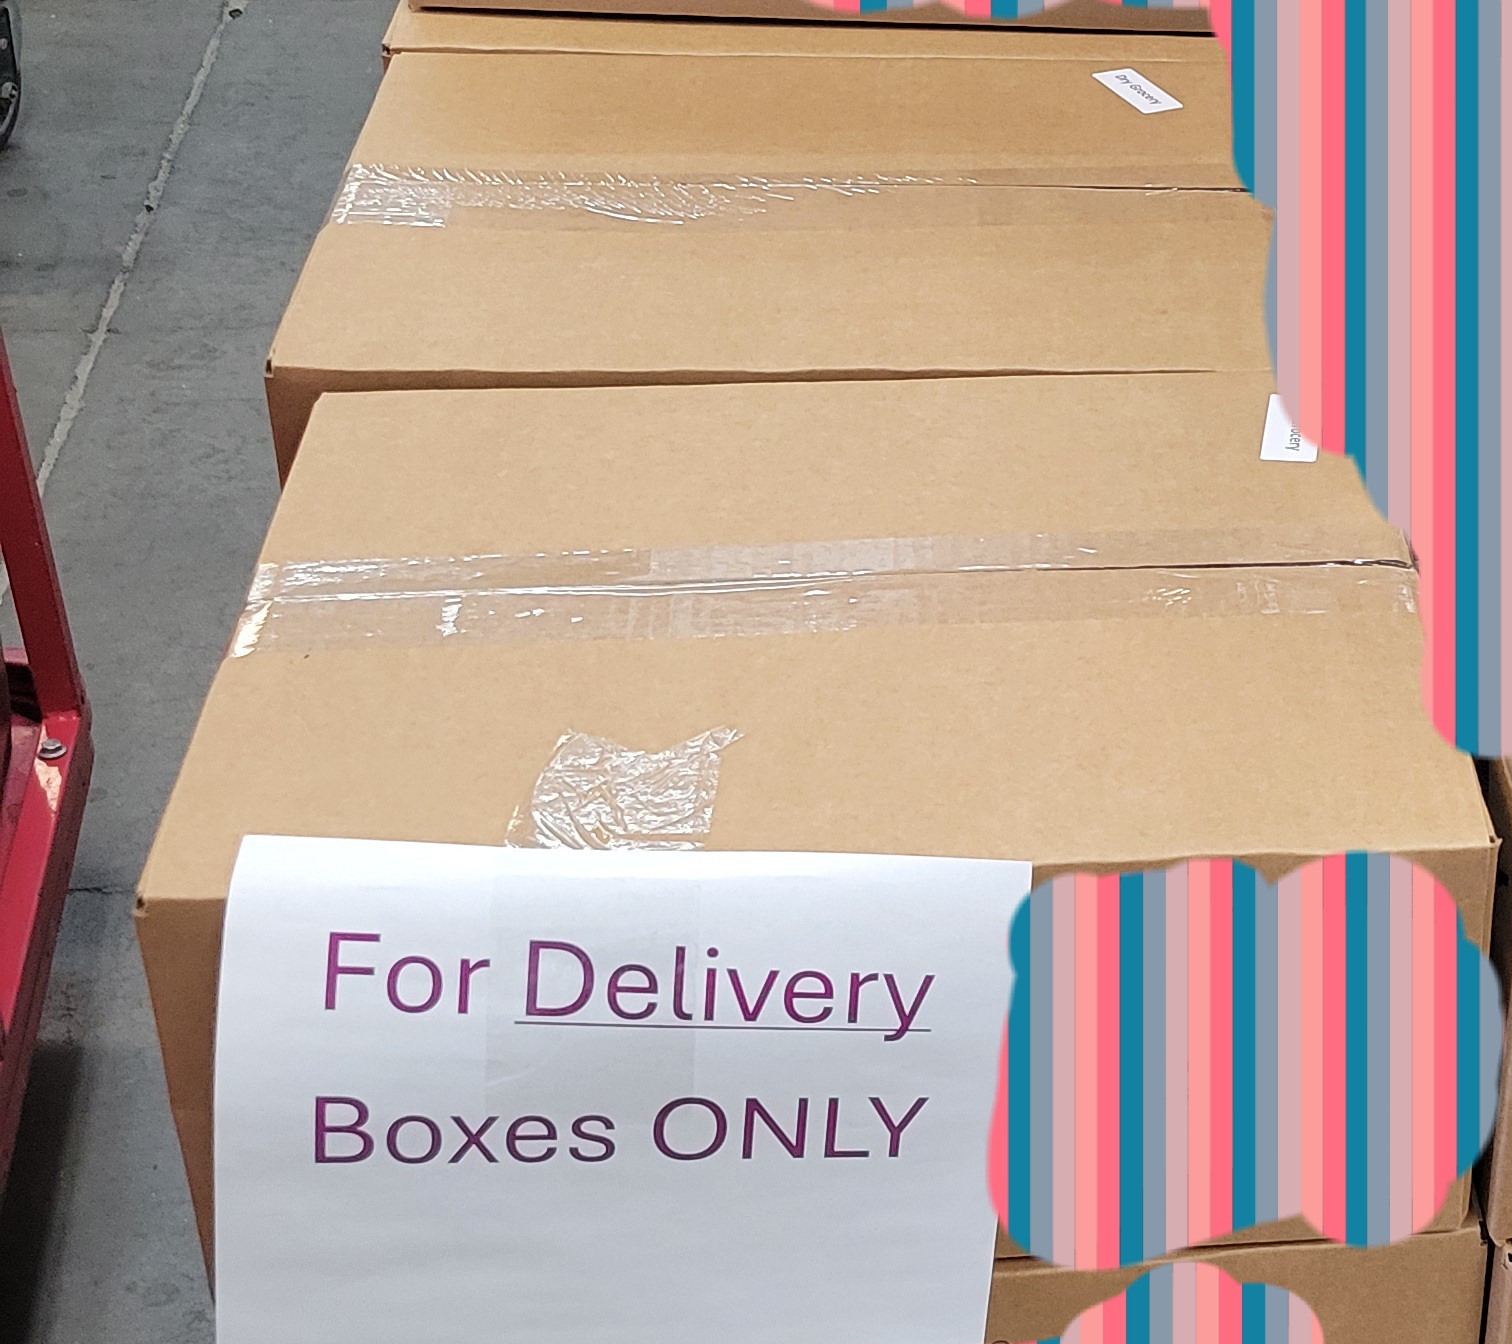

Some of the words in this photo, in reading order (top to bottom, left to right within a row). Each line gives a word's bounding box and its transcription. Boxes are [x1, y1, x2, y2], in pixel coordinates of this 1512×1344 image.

[1115, 74, 1131, 84] Dry
[1130, 84, 1162, 105] Grocery
[1285, 426, 1301, 452] ocery
[324, 931, 491, 1015] For
[525, 938, 936, 1041] Delivery
[313, 1095, 617, 1166] Boxes
[652, 1096, 930, 1161] ONLY
